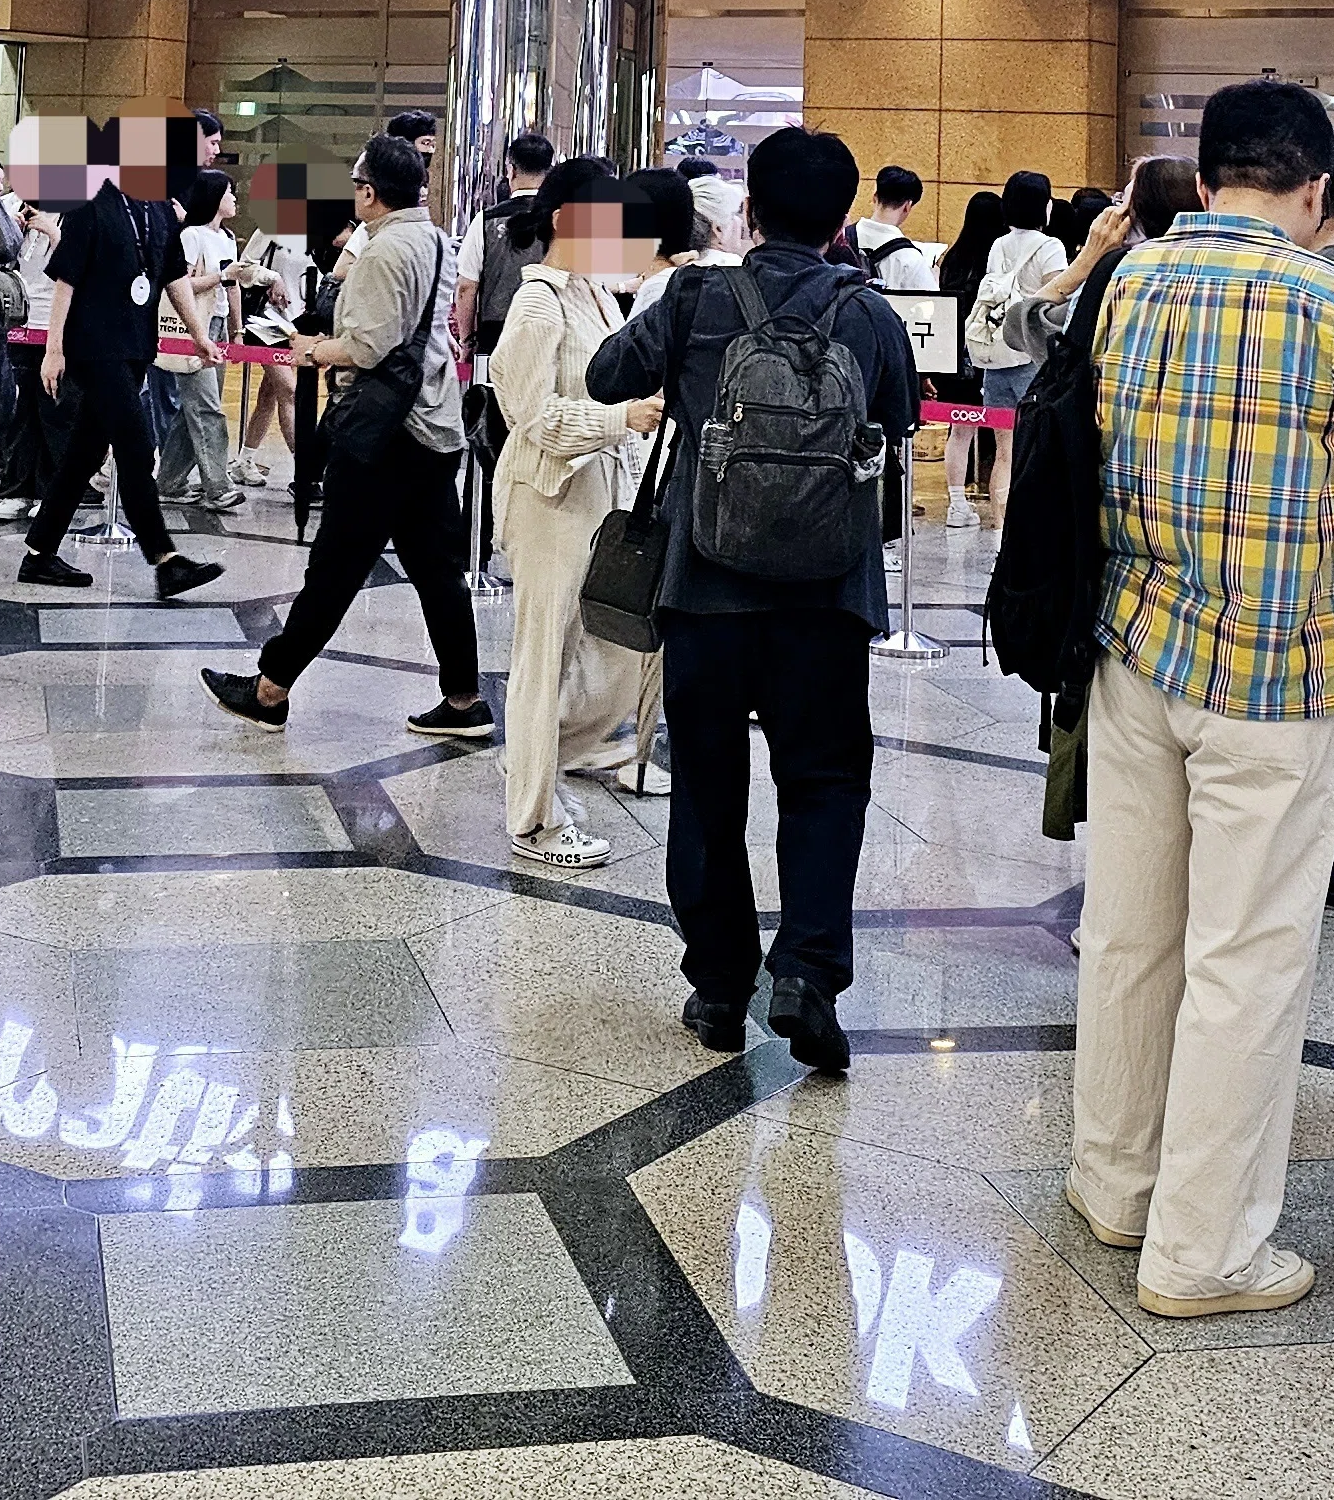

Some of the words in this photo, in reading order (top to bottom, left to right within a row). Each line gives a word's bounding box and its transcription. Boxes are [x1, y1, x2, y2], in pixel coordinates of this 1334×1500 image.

[906, 321, 935, 349] 구
[272, 352, 296, 364] coe
[950, 407, 987, 423] coex
[543, 851, 582, 864] crocs
